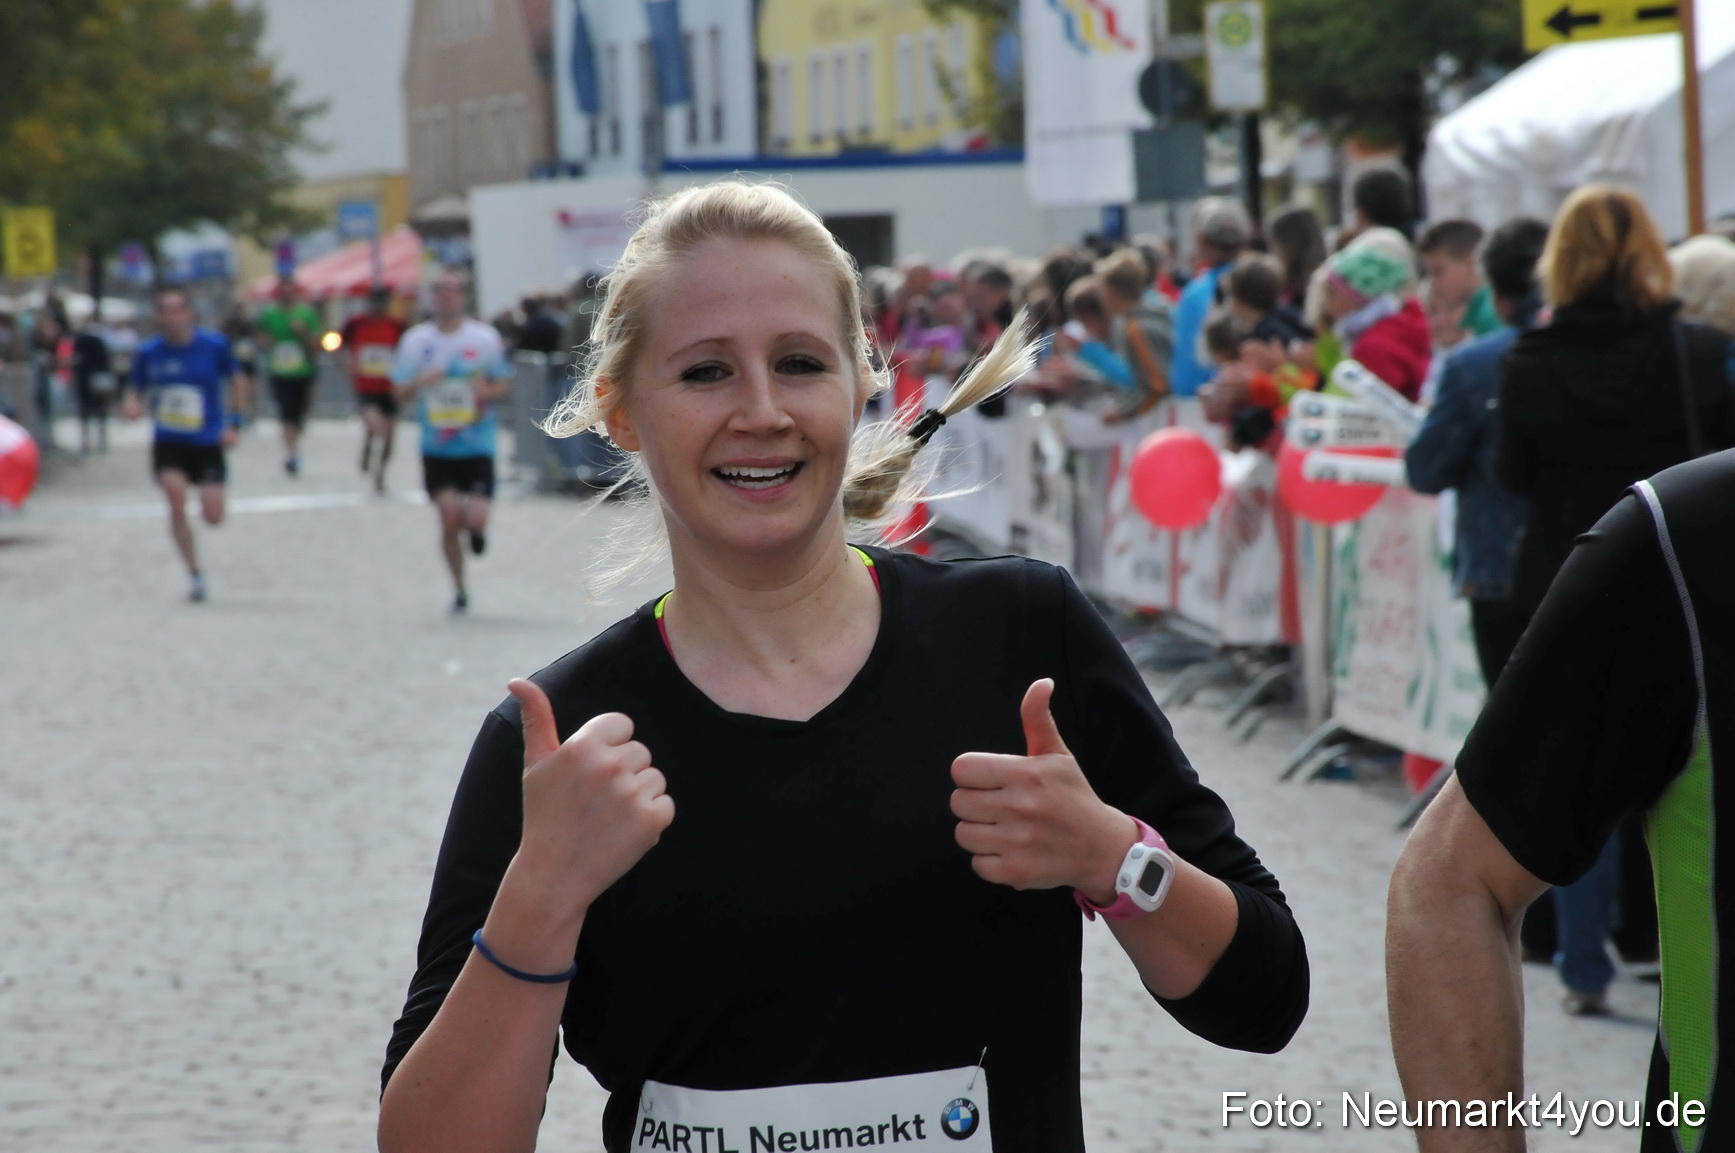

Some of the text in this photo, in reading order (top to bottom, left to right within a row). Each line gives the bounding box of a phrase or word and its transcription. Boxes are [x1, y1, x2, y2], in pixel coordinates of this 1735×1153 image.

[943, 1099, 976, 1115] BMW
[638, 1113, 926, 1153] PARTL Neumarkt
